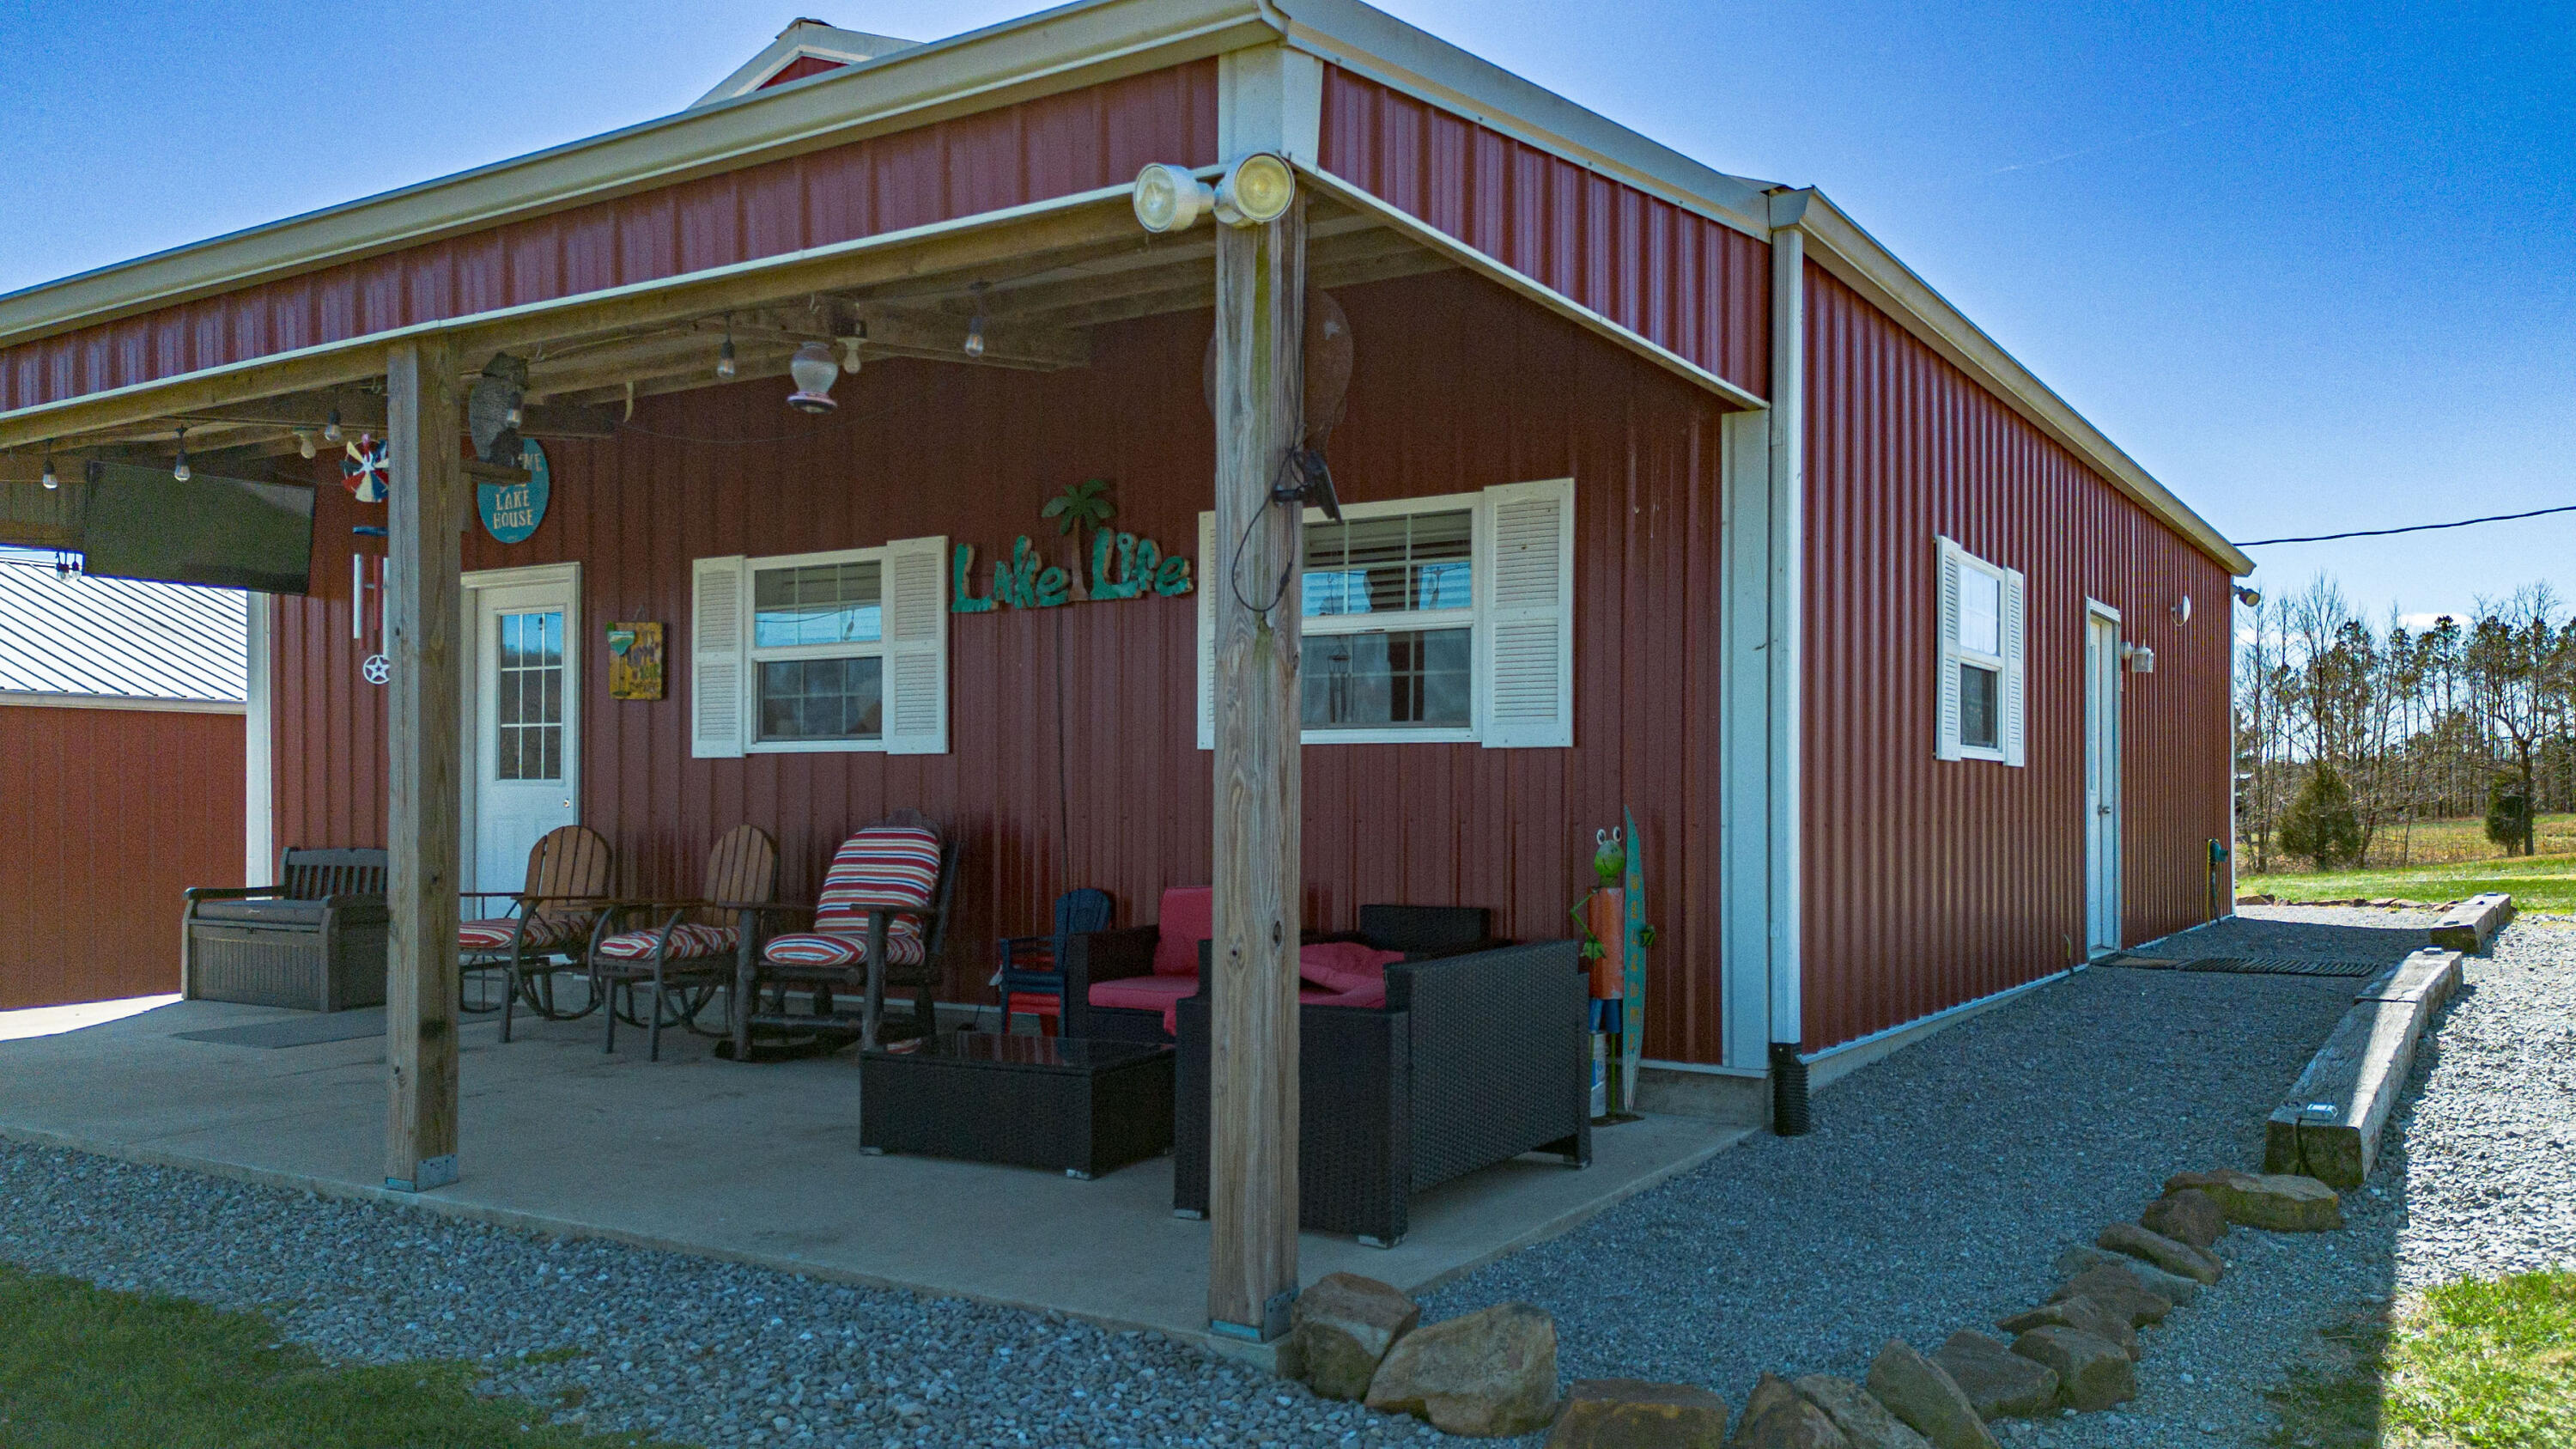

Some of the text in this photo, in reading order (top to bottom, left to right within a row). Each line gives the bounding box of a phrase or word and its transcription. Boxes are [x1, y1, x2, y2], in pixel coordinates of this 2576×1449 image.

[495, 490, 530, 511] LAKE
[493, 508, 533, 530] HOUSE
[1091, 527, 1191, 600] Life
